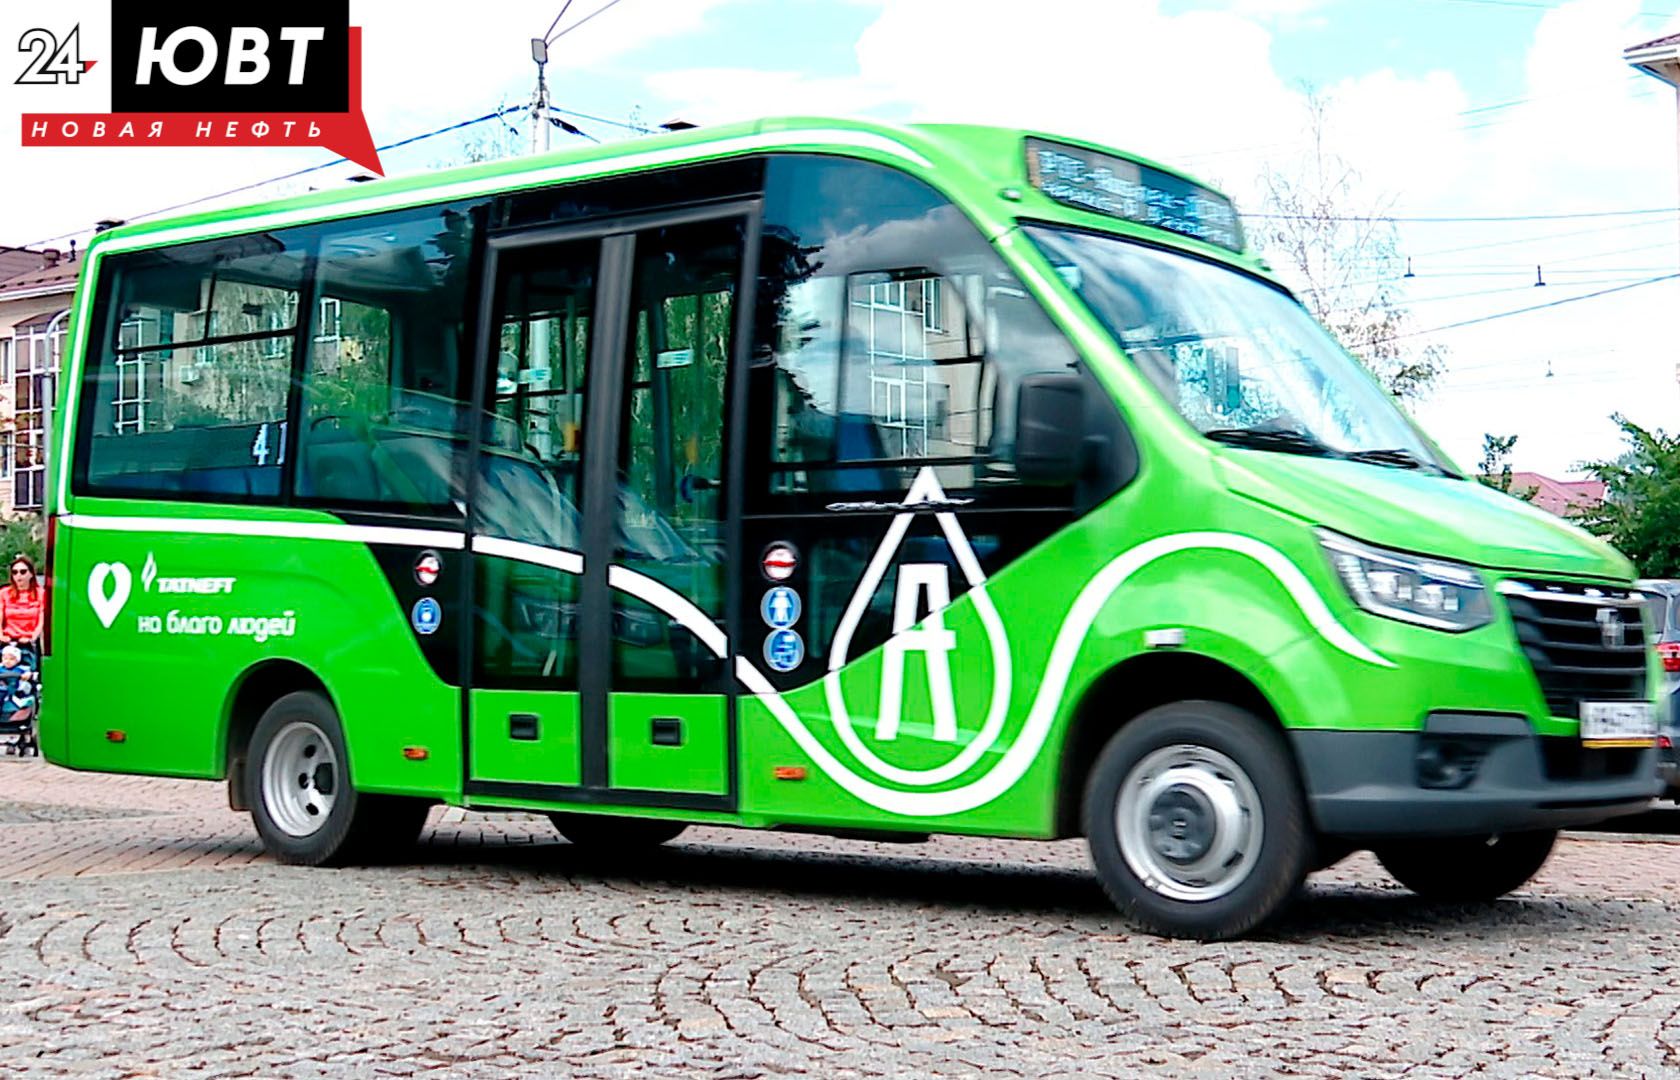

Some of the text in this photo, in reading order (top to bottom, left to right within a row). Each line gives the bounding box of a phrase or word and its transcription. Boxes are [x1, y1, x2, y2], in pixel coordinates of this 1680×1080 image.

[137, 609, 297, 642] на благо людей
